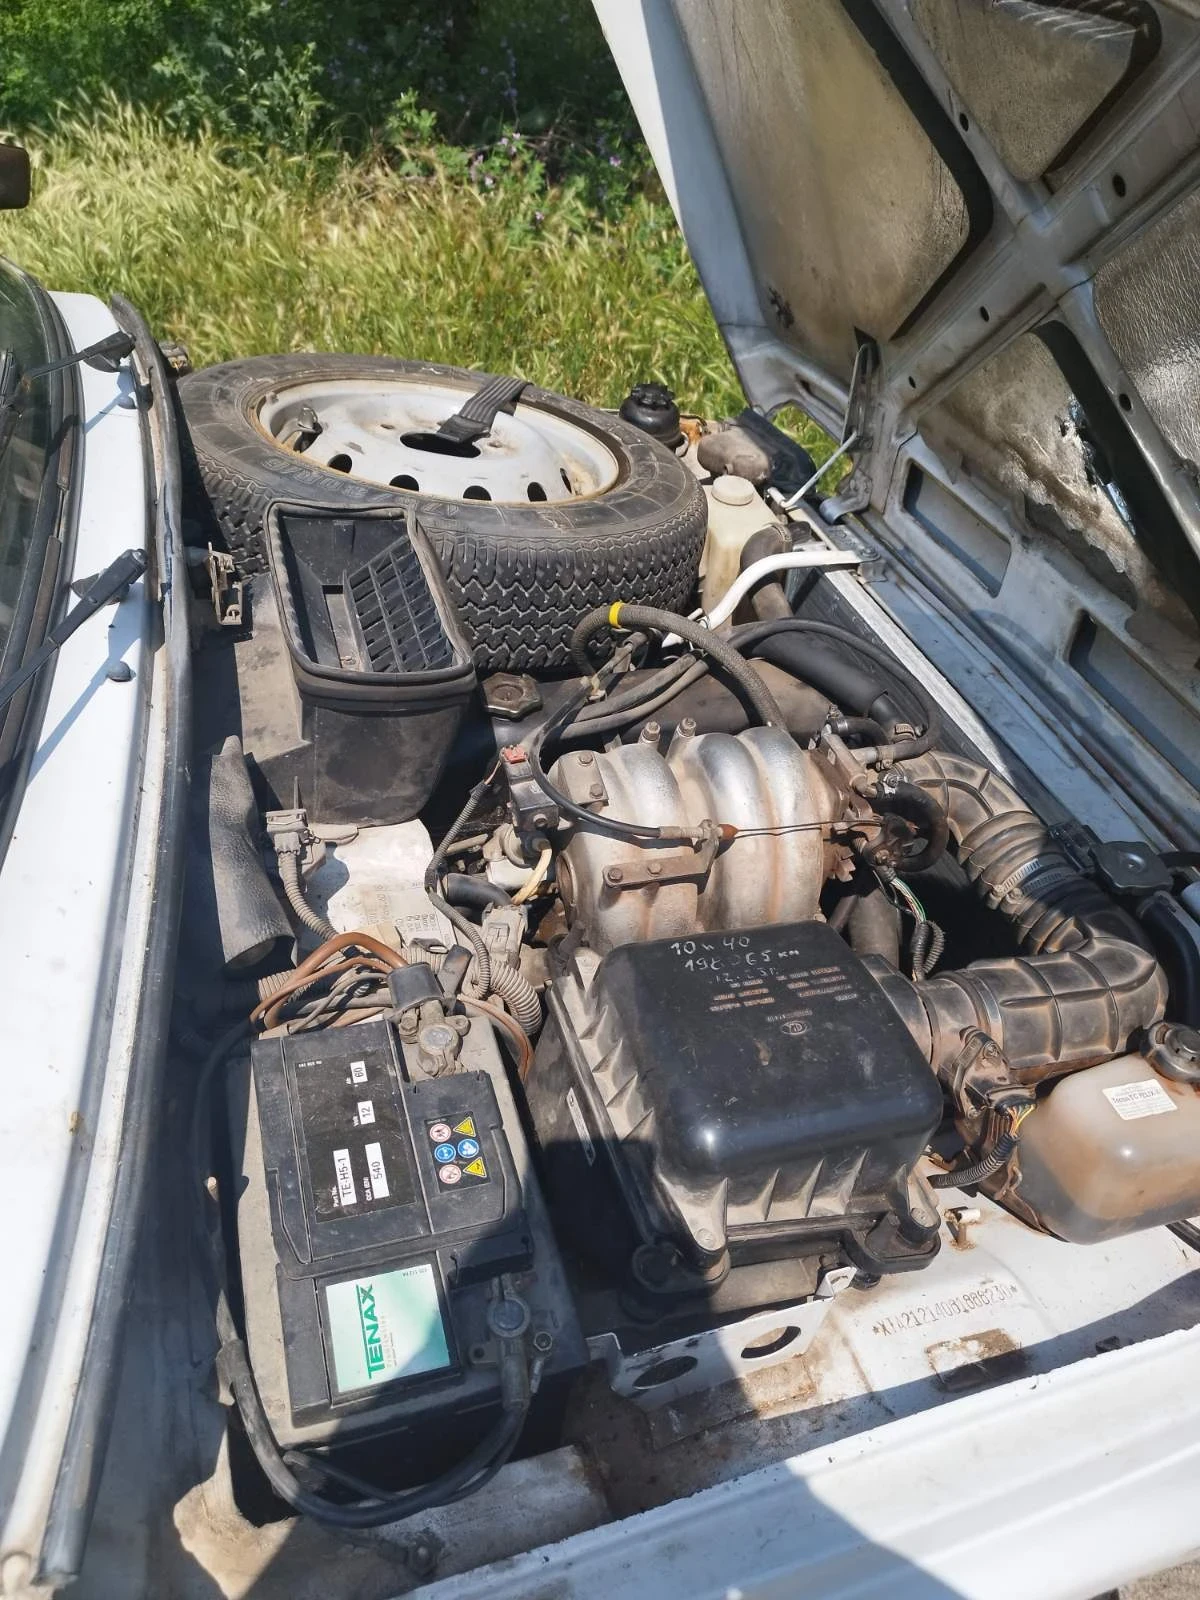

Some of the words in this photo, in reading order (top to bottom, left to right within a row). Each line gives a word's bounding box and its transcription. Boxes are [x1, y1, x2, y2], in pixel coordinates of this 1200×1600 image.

[670, 940, 697, 956] 10
[722, 936, 751, 951] 40
[353, 1067, 364, 1077] 60
[361, 1106, 371, 1118] 12
[337, 1157, 353, 1198] TE-H5-1
[371, 1161, 383, 1180] 540
[355, 1283, 386, 1380] TENAX
